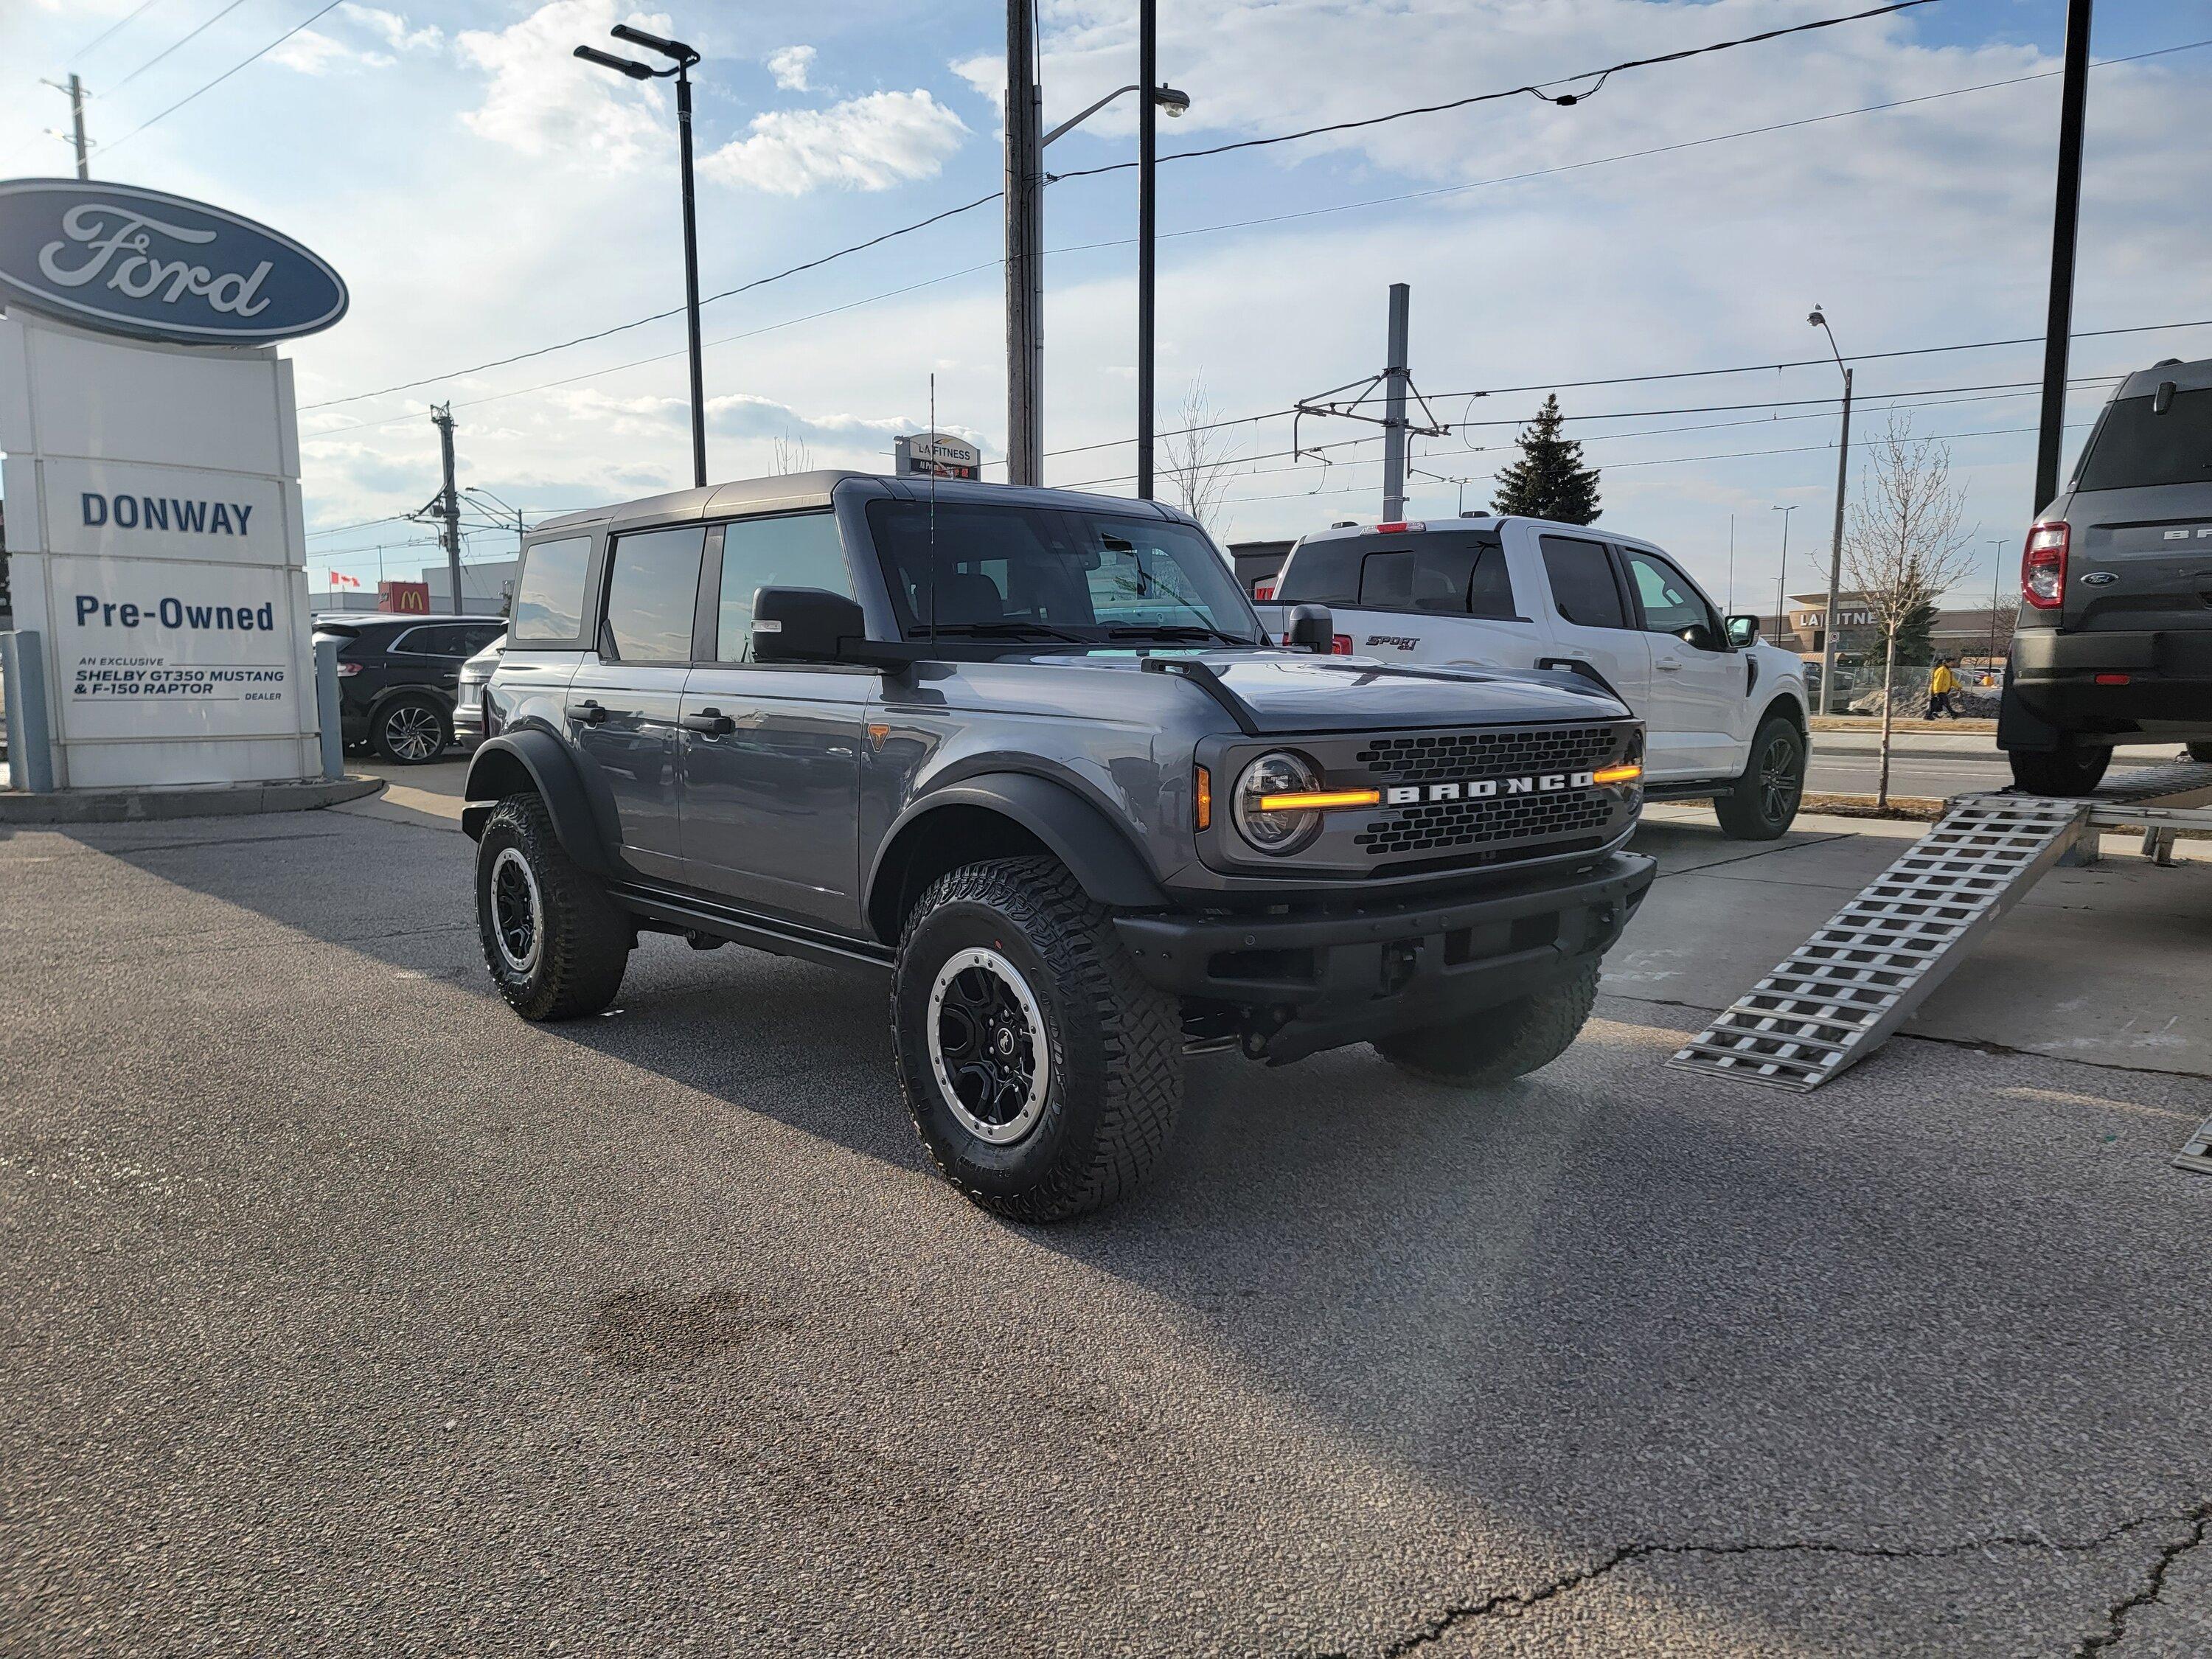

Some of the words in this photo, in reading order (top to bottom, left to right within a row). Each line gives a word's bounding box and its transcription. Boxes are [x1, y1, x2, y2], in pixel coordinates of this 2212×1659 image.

[39, 204, 274, 317] Ford
[919, 445, 931, 453] LA
[933, 446, 970, 461] FITNESS
[82, 493, 253, 536] DONWAY
[75, 595, 274, 631] Pre-Owned
[1800, 613, 1819, 626] LA
[1366, 635, 1421, 651] SPORT
[78, 657, 97, 666] AN
[100, 658, 164, 666] EXCLUSIVE
[75, 670, 147, 681] SHELBY
[150, 671, 204, 681] GT350
[209, 671, 285, 682] MUSTANG
[74, 684, 87, 694] &
[92, 684, 140, 695] F-150
[144, 684, 214, 695] RAPTOR
[245, 692, 282, 700] DEALER
[1387, 772, 1594, 804] BRONCO
